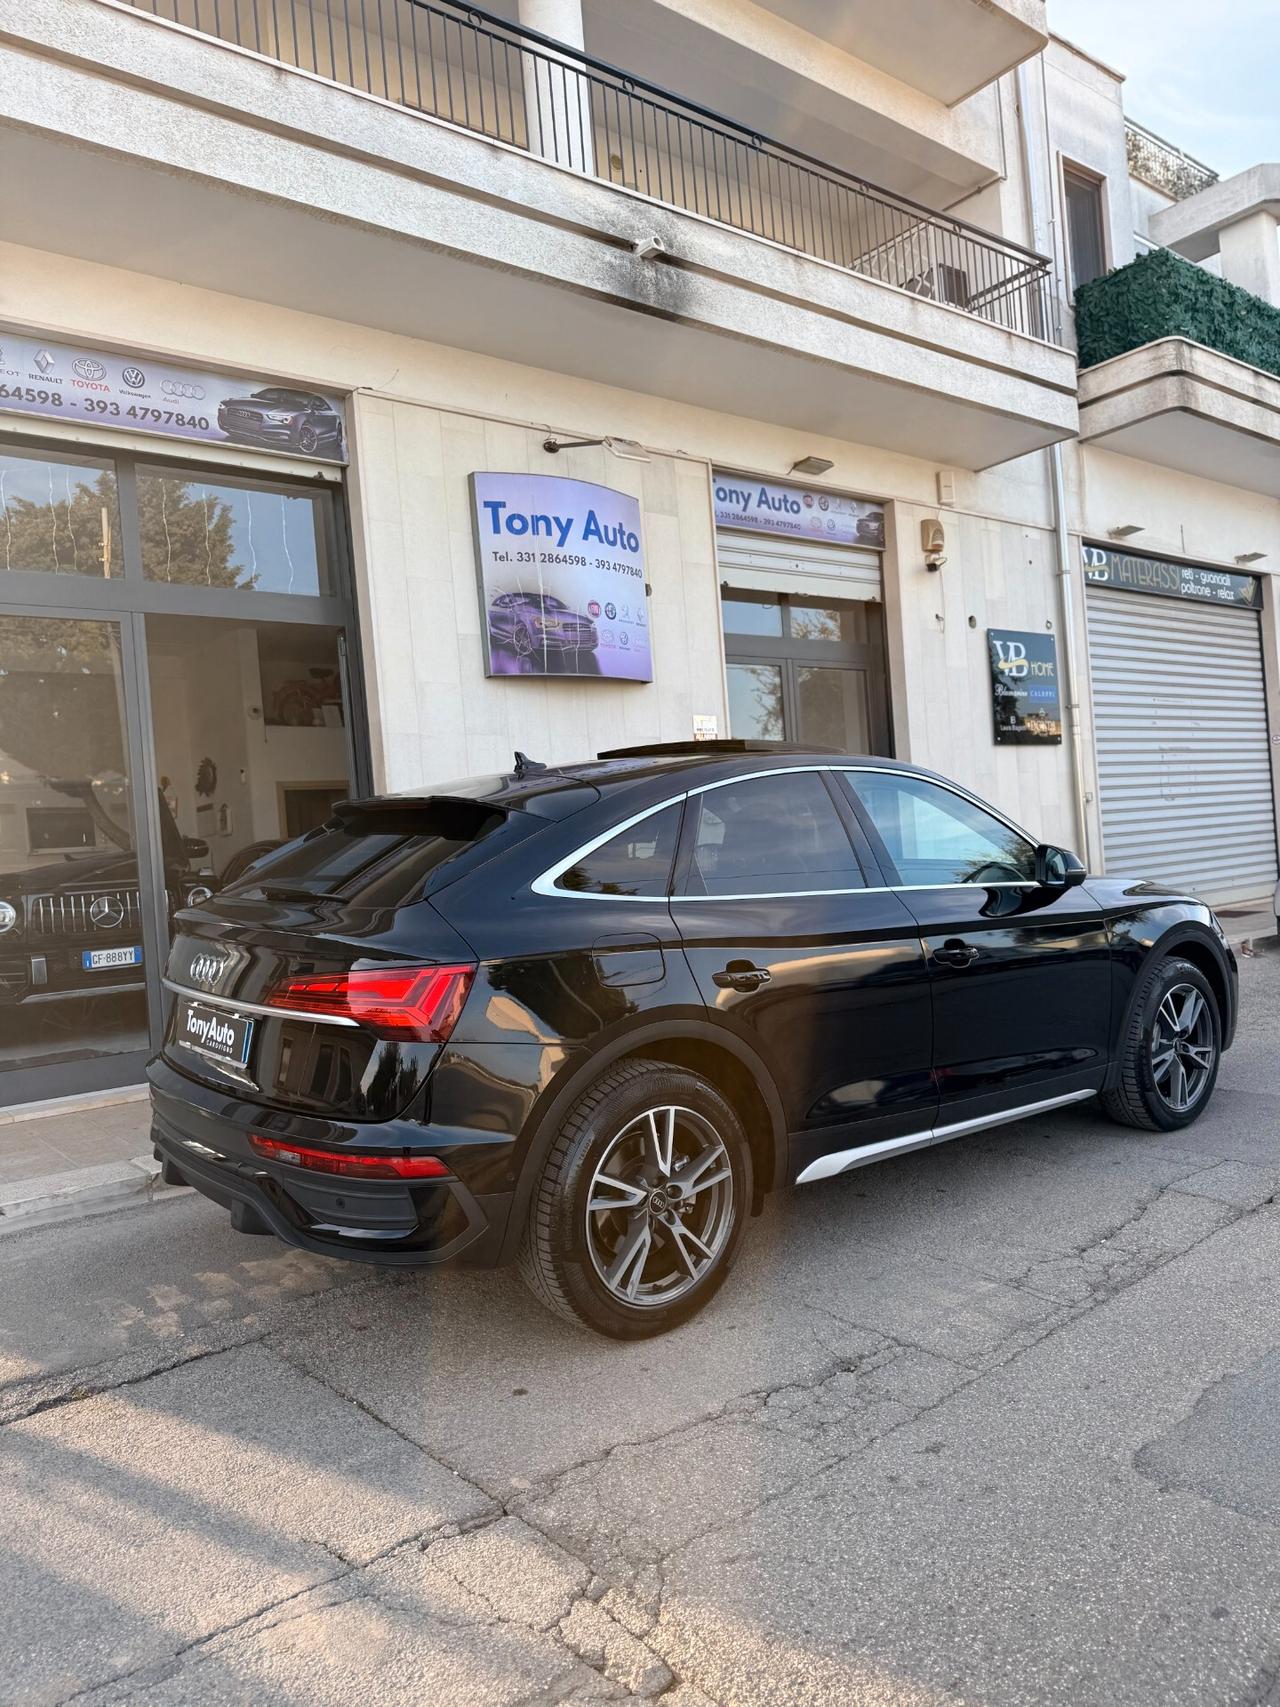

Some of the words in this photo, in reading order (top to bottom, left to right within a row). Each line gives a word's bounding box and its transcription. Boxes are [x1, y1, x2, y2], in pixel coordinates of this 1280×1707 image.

[28, 373, 63, 385] RENAULT
[70, 379, 111, 393] TOYOTA
[119, 389, 152, 399] Volkswagen
[84, 397, 120, 416] 393
[126, 405, 210, 431] 4797840
[757, 487, 801, 514] Auto
[483, 500, 574, 548] Tony
[582, 509, 640, 553] Auto
[492, 551, 513, 562] Tel.
[517, 551, 536, 563] 331
[540, 552, 587, 567] 2864598
[595, 558, 611, 571] 393
[612, 561, 643, 579] 4797840
[1181, 567, 1194, 581] reti
[1181, 581, 1211, 598] poltrone
[1217, 586, 1235, 600] relax
[1031, 661, 1055, 677] HOME
[186, 1009, 235, 1046] TonyAuto
